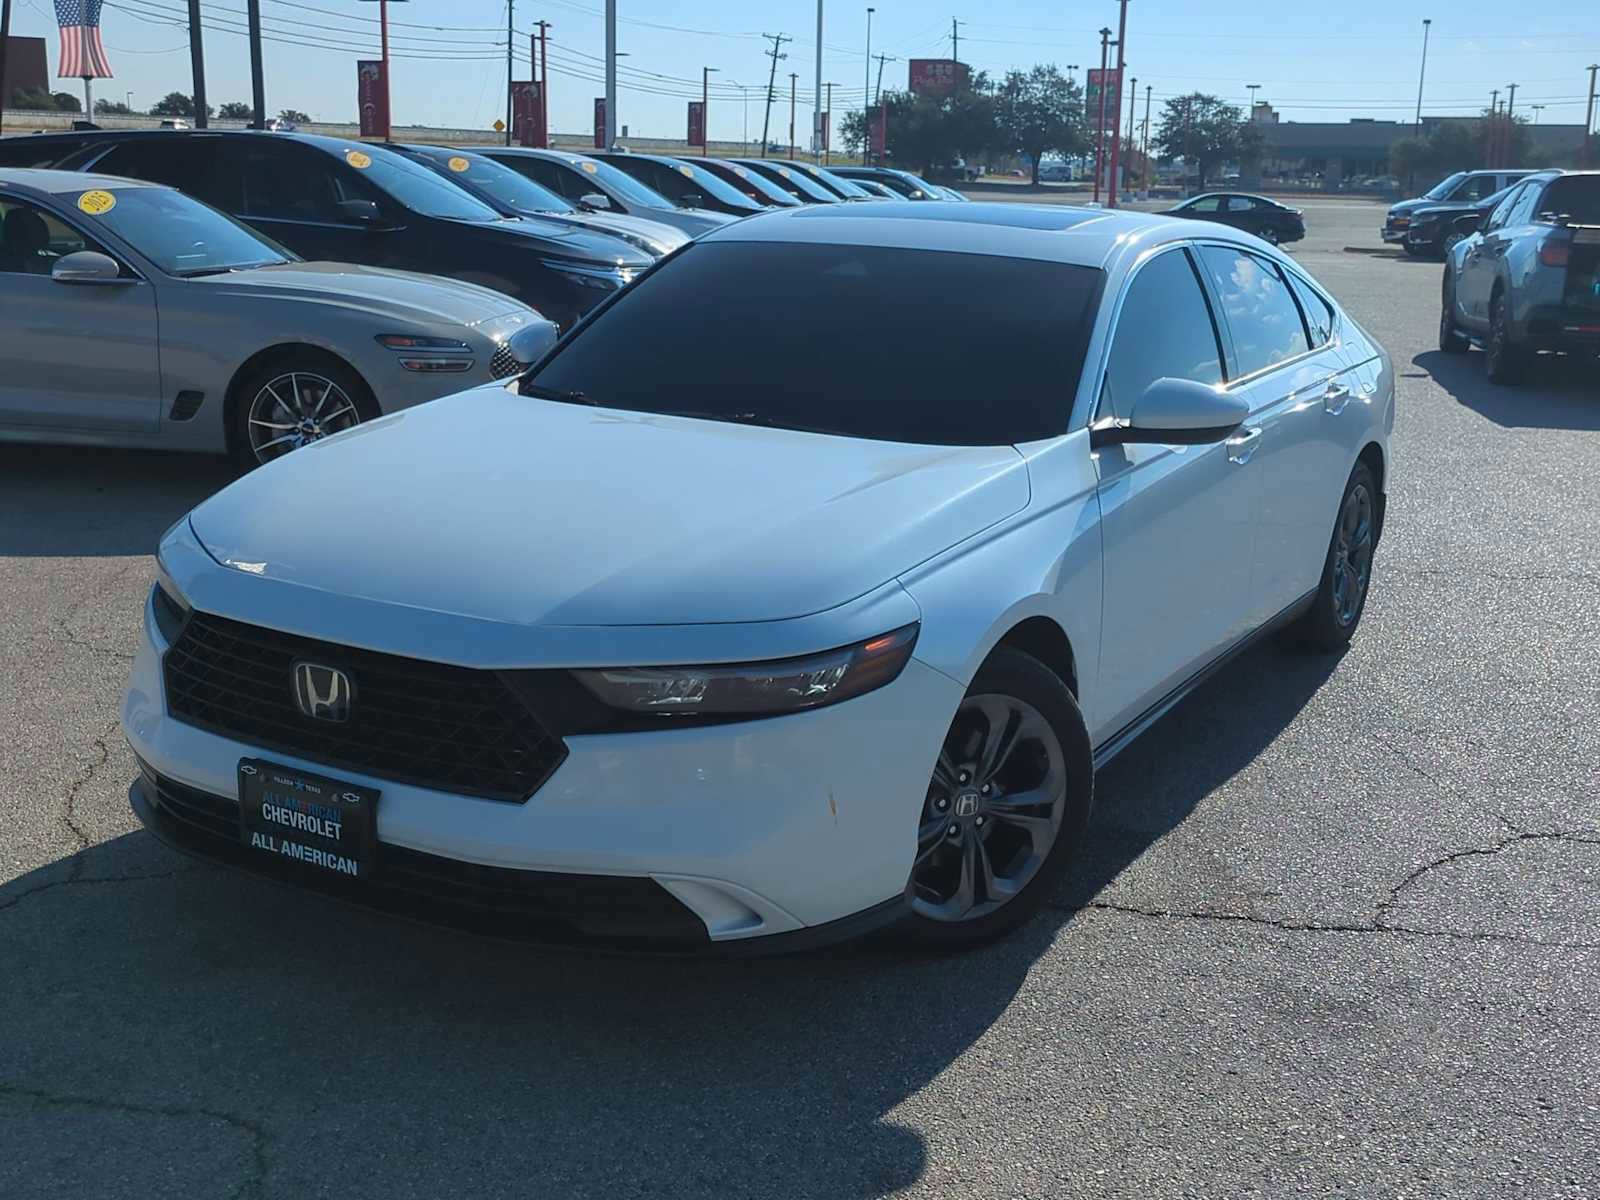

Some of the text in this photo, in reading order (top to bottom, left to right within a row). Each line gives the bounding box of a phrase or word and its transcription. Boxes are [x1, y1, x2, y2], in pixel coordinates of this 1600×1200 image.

[262, 803, 342, 841] CHEVROLET
[251, 831, 358, 876] ALL AMERICAN
